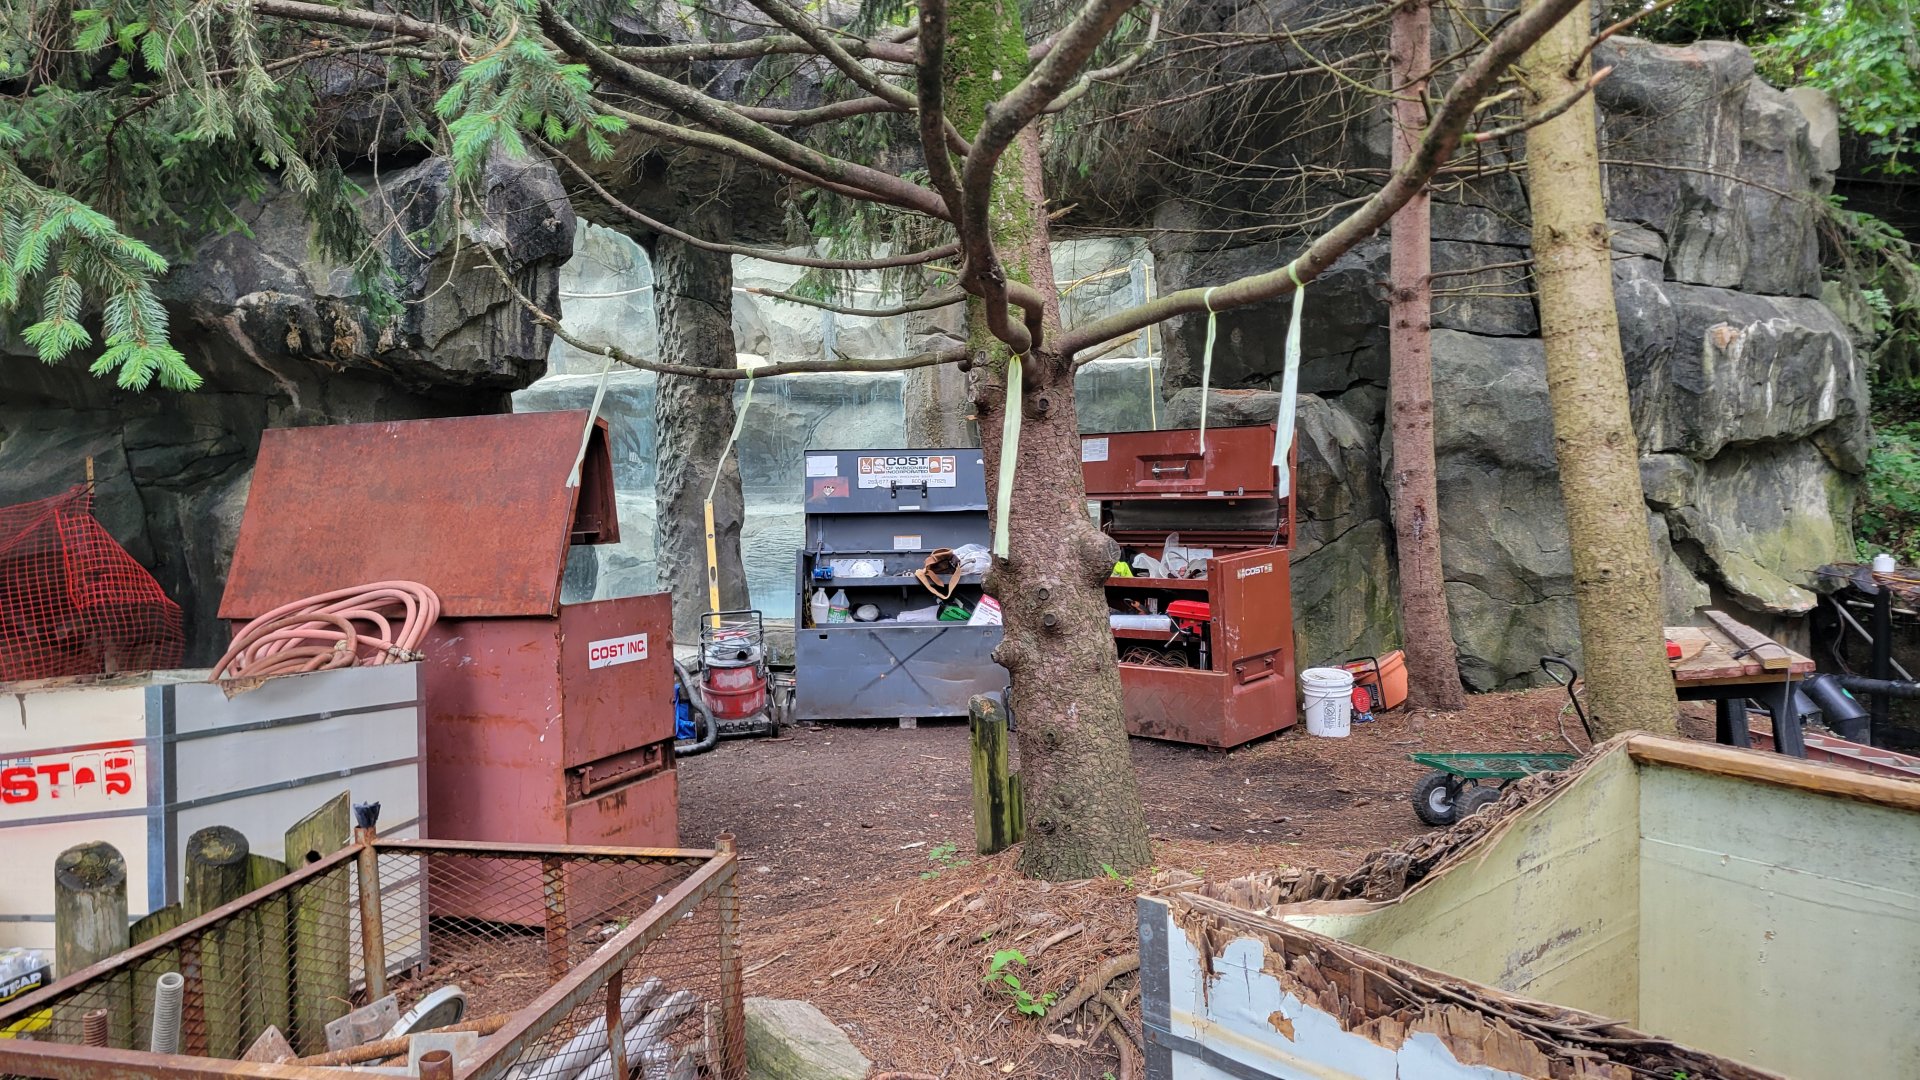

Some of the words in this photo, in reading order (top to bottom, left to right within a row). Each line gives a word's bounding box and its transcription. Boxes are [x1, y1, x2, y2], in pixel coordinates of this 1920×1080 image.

[886, 457, 928, 466] COST
[1245, 566, 1265, 576] COST
[591, 644, 625, 661] COST
[627, 640, 646, 654] INC.
[0, 763, 70, 804] ST
